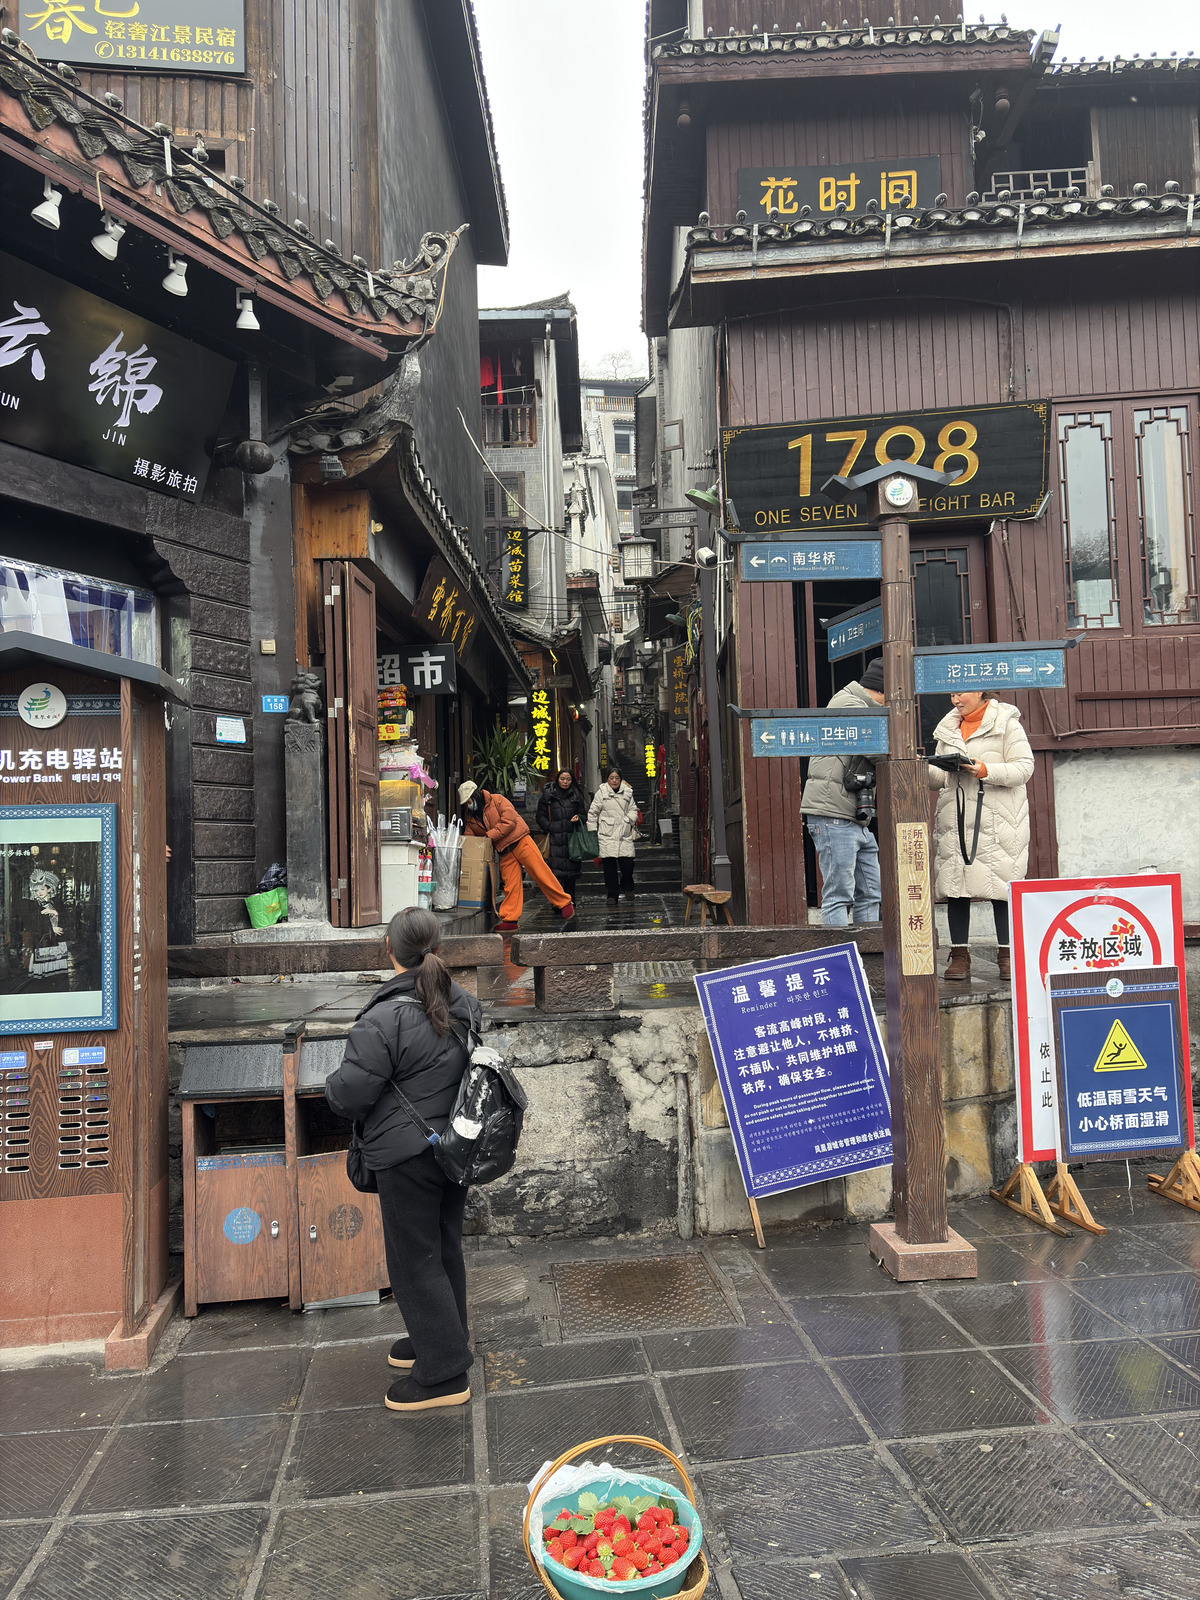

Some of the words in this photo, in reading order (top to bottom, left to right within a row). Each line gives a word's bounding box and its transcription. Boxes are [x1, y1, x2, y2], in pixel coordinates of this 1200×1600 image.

[104, 20, 236, 47] 轻奢江景民宿
[116, 44, 235, 65] 13141638876
[759, 170, 918, 215] 花时间
[0, 391, 20, 410] UN
[102, 429, 127, 446] JIN
[133, 457, 198, 494] 摄影旅拍
[754, 509, 791, 526] ONE
[800, 504, 858, 522] SEVEN
[980, 491, 1015, 508] BAR
[793, 551, 836, 566] 南华桥
[947, 662, 1010, 678] 沱江泛舟
[531, 690, 551, 771] 边城苗菜馆
[821, 726, 858, 741] 卫生间
[33, 774, 62, 783] Bank
[913, 828, 924, 871] 所在位置
[907, 884, 924, 931] 雪桥
[1059, 935, 1143, 961] 禁放区域
[731, 968, 831, 1004] 温馨提示
[741, 1002, 777, 1014] Reminder
[754, 1007, 850, 1039] 客流高峰时段，请
[733, 1024, 862, 1061] 注意避让他人，不推挤、
[737, 1041, 858, 1078] 不插队，共同维护拍照
[741, 1066, 833, 1096] 秩序，确保安全。
[818, 1093, 837, 1101] together
[843, 1087, 862, 1095] maintain
[1077, 1086, 1168, 1108] 低温雨雪天气
[1078, 1110, 1170, 1132] 小心桥面湿滑
